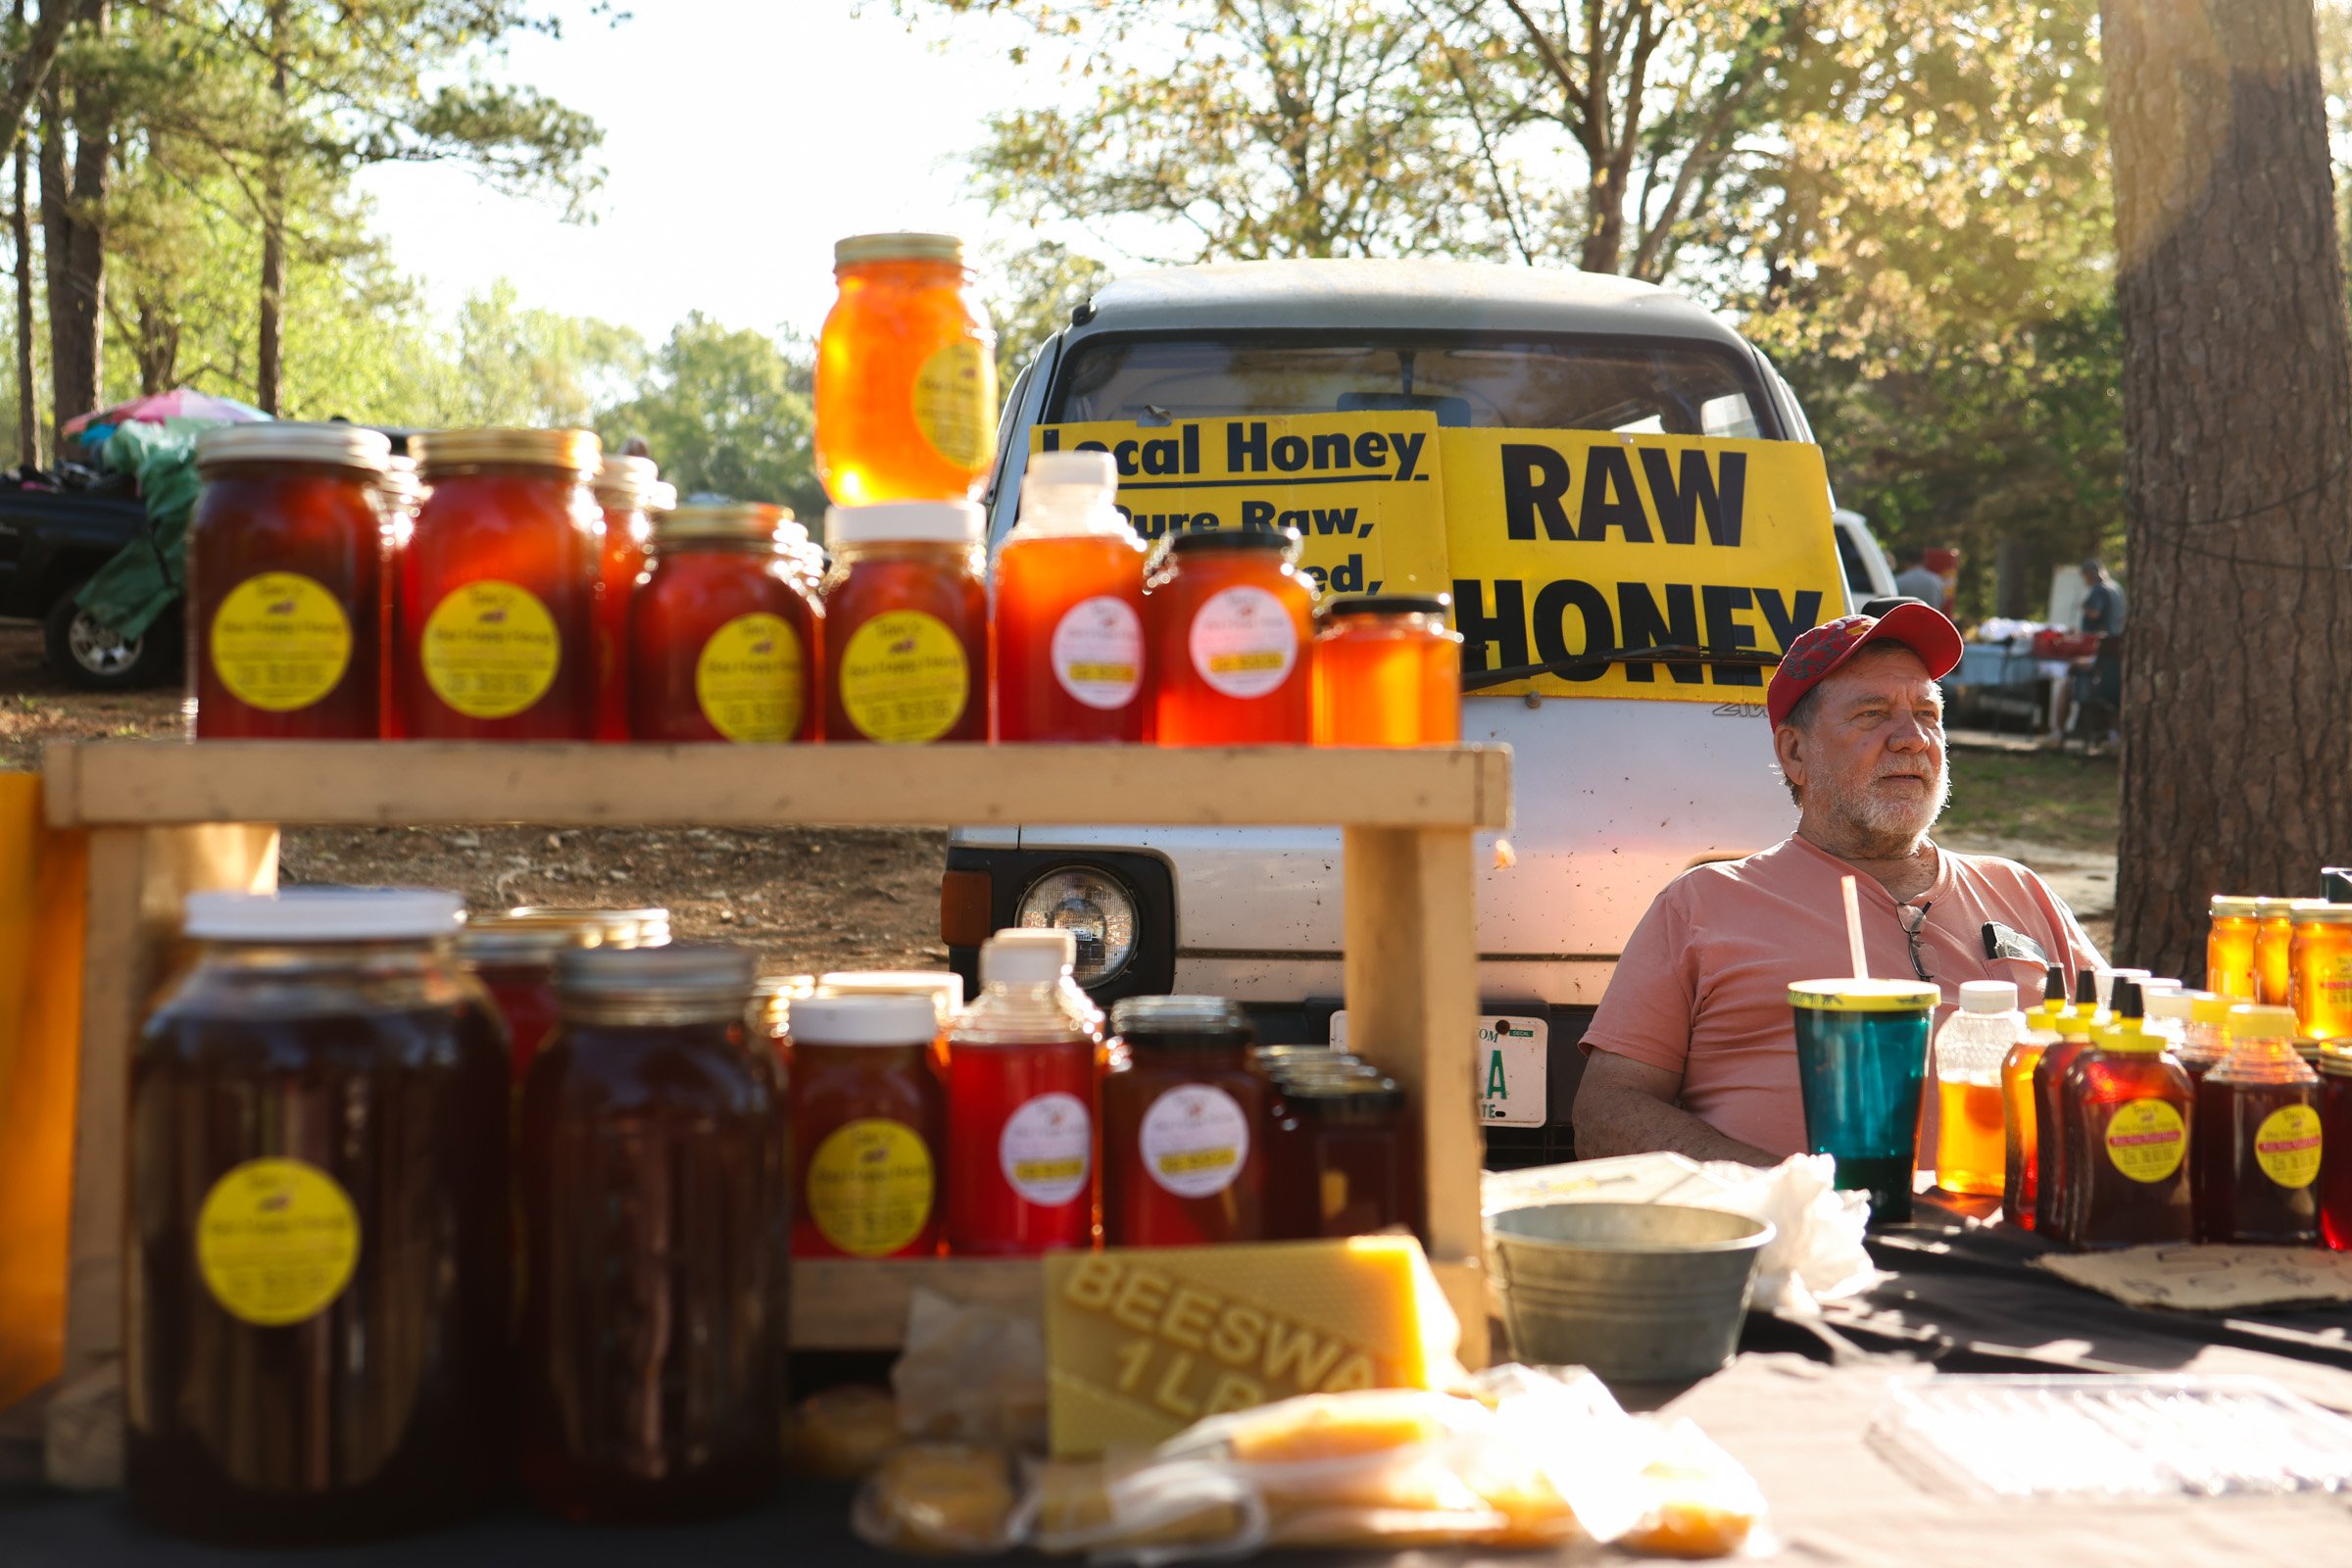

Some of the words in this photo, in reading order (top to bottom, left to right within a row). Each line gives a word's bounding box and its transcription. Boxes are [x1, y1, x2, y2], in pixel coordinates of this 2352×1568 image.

[1227, 422, 1427, 480] Honey
[1501, 444, 1747, 547] RAW
[1242, 501, 1375, 539] Raw,
[1452, 579, 1823, 688] HONEY
[1065, 1255, 1374, 1392] BEESWA
